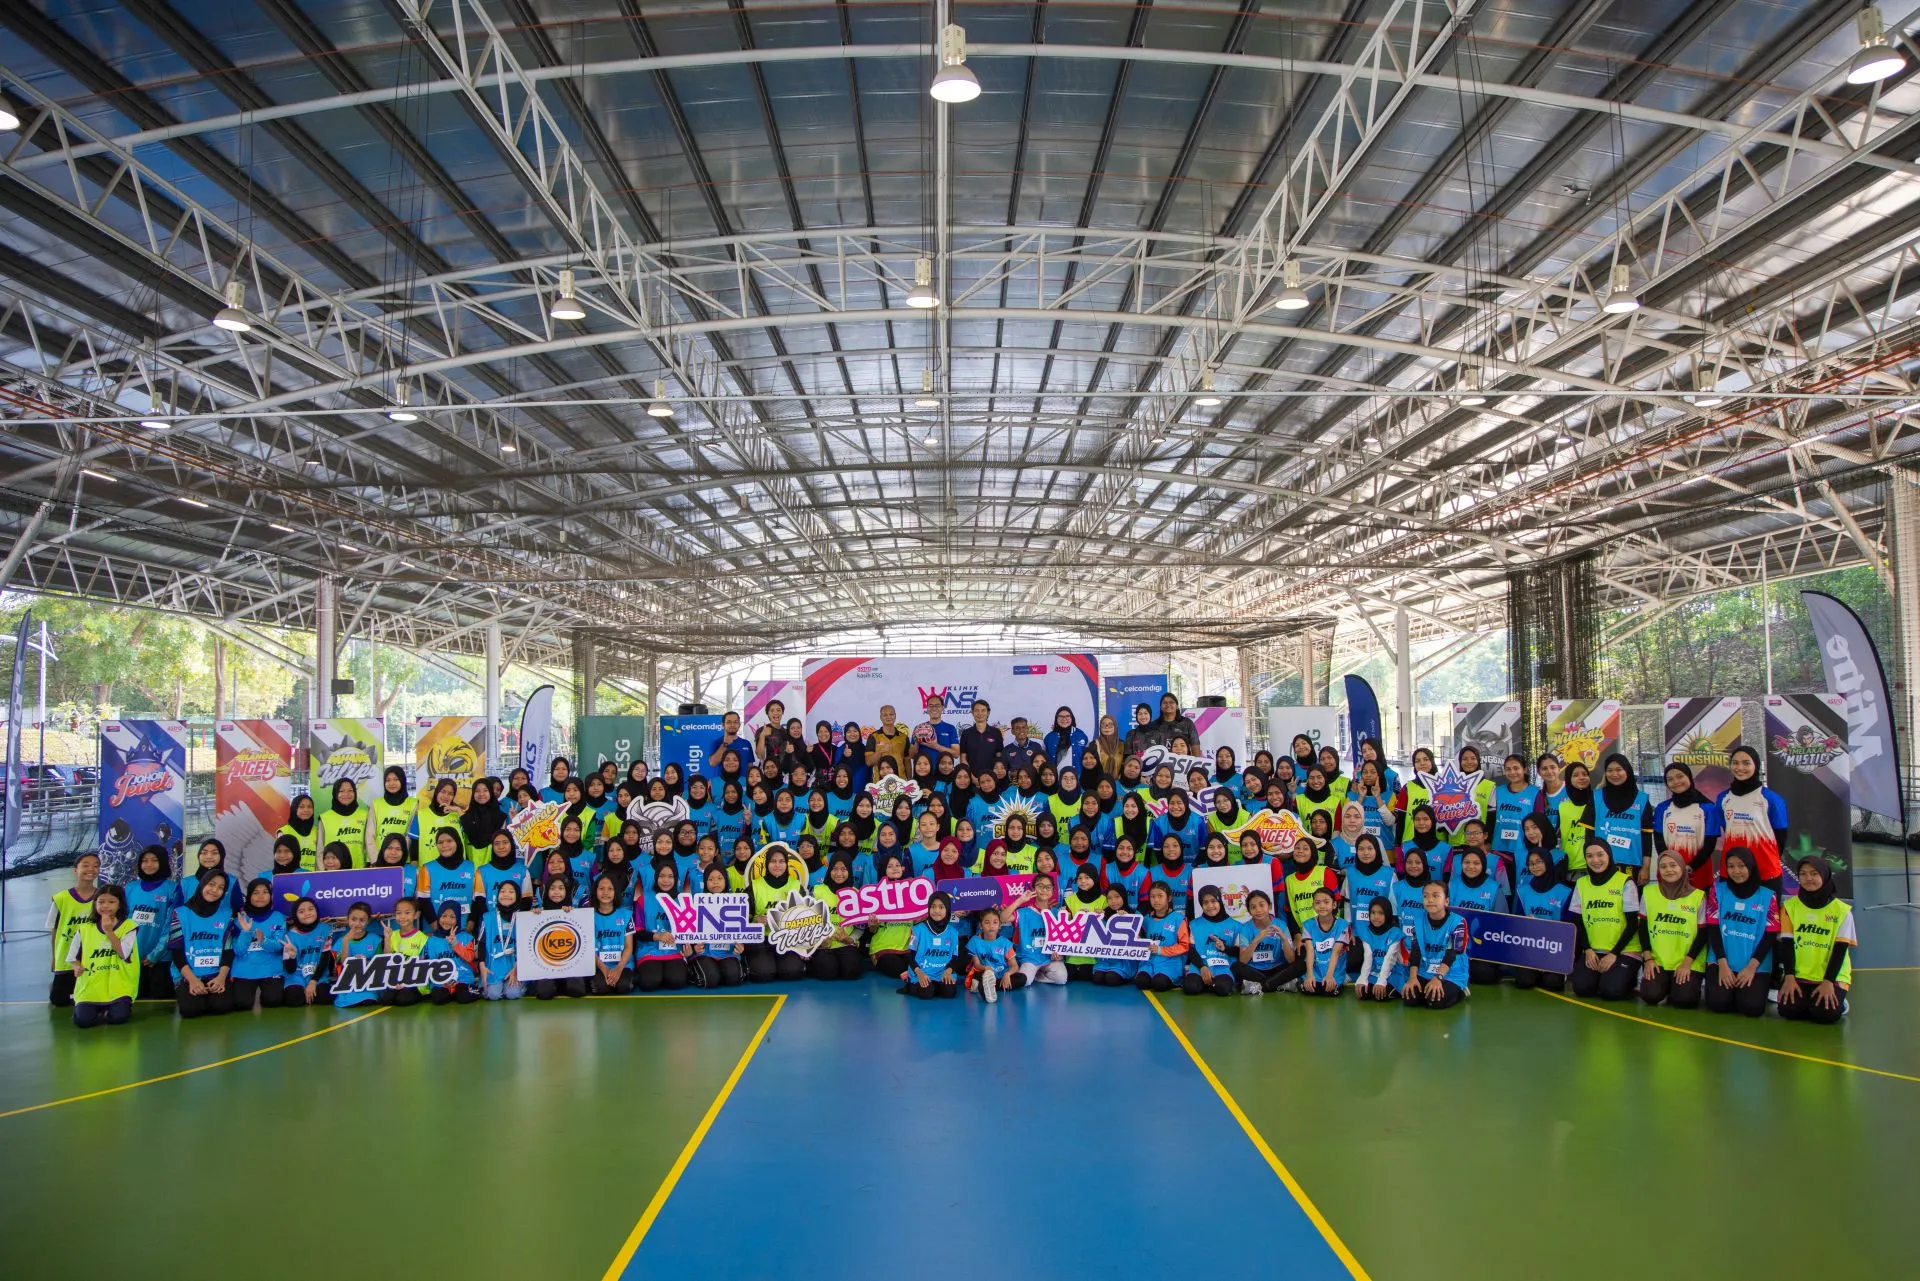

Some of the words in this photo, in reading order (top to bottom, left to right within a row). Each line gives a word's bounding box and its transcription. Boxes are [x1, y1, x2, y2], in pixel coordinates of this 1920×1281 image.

[1124, 684, 1162, 692] celcomdigi
[1826, 634, 1884, 771] Mitre
[681, 723, 724, 735] celcomdig
[615, 739, 631, 771] ESG
[1673, 755, 1730, 768] SUNSHINE
[227, 760, 278, 785] ANGELS
[110, 771, 174, 806] Jewels
[1431, 802, 1478, 821] Jewels
[1442, 802, 1466, 811] JOHOR
[382, 818, 407, 826] Mitre
[1611, 838, 1626, 846] 242
[315, 884, 392, 900] celcomdigi
[440, 882, 466, 890] Mitre
[698, 896, 747, 904] KLINIK
[838, 878, 933, 916] astro
[960, 889, 997, 898] celcomdigi
[1586, 900, 1614, 910] Mitre
[785, 914, 822, 930] PAHANG
[1654, 912, 1688, 926] Mitre
[1722, 911, 1756, 925] Mitre
[190, 932, 220, 941] Mitre
[1797, 924, 1830, 936] Mitre
[548, 938, 573, 949] KBS
[1484, 930, 1562, 954] celcomdigi
[1044, 944, 1084, 954] NETBALL
[1084, 946, 1112, 956] SUPER
[1112, 948, 1148, 958] LEAGUE
[332, 956, 454, 993] Mitre
